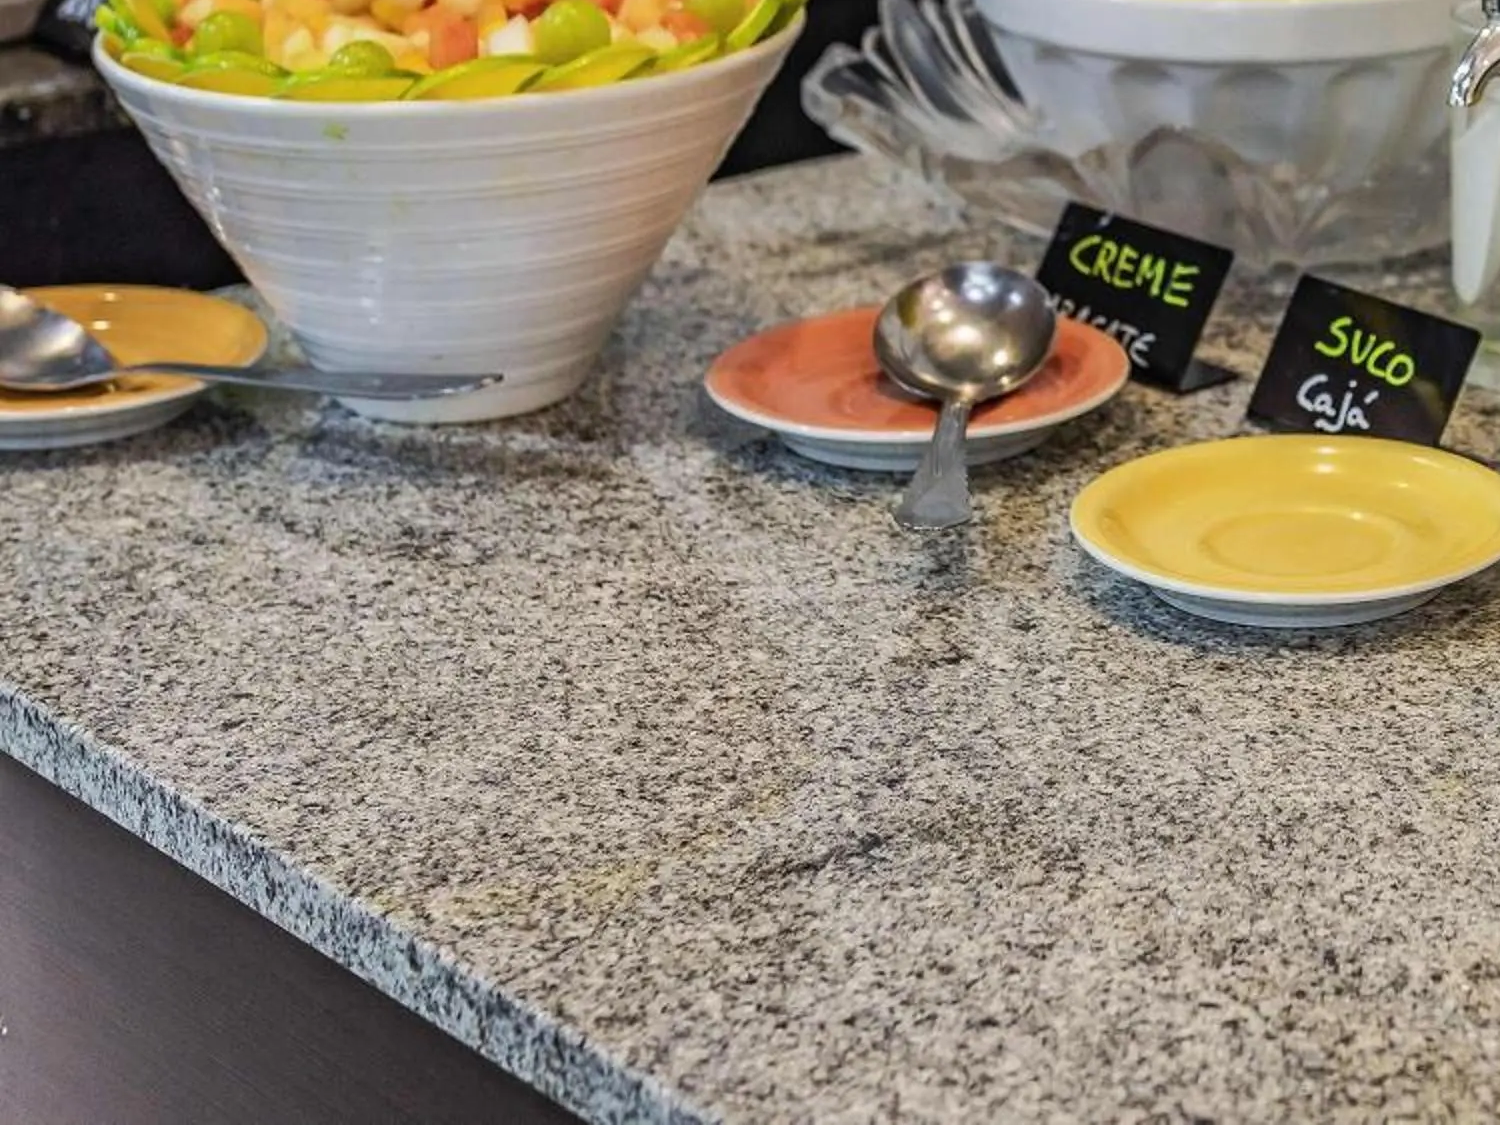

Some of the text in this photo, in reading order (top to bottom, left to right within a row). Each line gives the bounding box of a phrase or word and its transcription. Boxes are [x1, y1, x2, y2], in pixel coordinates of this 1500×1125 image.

[1069, 234, 1200, 307] CREME
[1314, 316, 1415, 386] SUCO
[1296, 374, 1380, 433] Cajá
